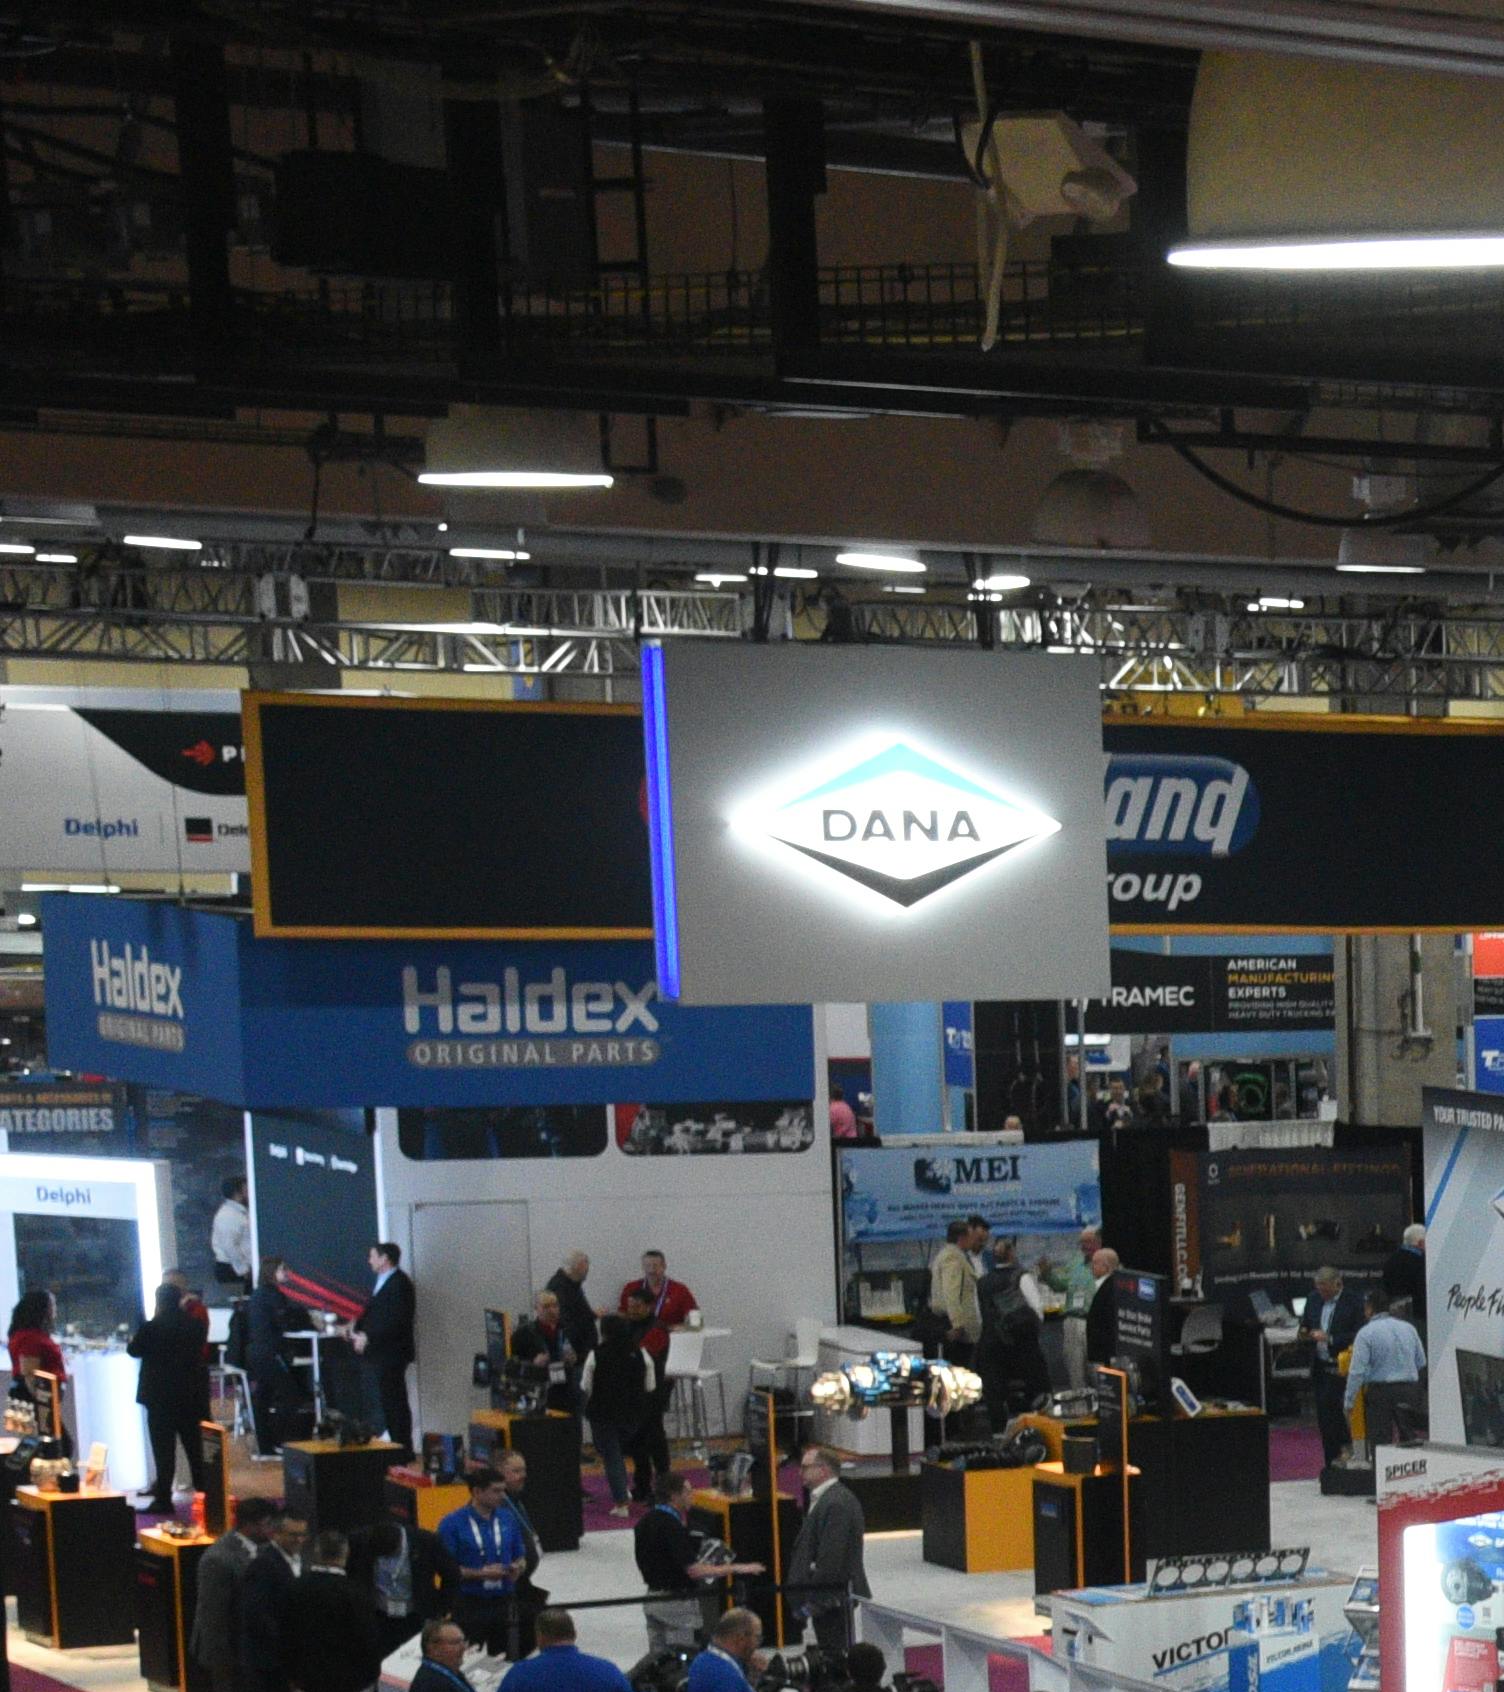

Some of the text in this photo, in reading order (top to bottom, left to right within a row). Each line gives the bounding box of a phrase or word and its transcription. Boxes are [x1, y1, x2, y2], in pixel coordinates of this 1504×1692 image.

[64, 818, 139, 839] Delphi
[823, 809, 981, 842] DANA
[1228, 959, 1297, 970] AMERICAN
[91, 938, 184, 1019] Haldex
[403, 966, 660, 1033] Haldex
[1229, 987, 1287, 998] EXPERTS
[414, 1041, 655, 1067] ORIGINAL PARTS
[1434, 1107, 1457, 1126] YOUR
[1458, 1109, 1492, 1130] TRUSTED
[954, 1155, 1021, 1183] MEI
[36, 1186, 92, 1205] Delphi
[1448, 1283, 1488, 1320] People
[1385, 1459, 1428, 1479] SPICER
